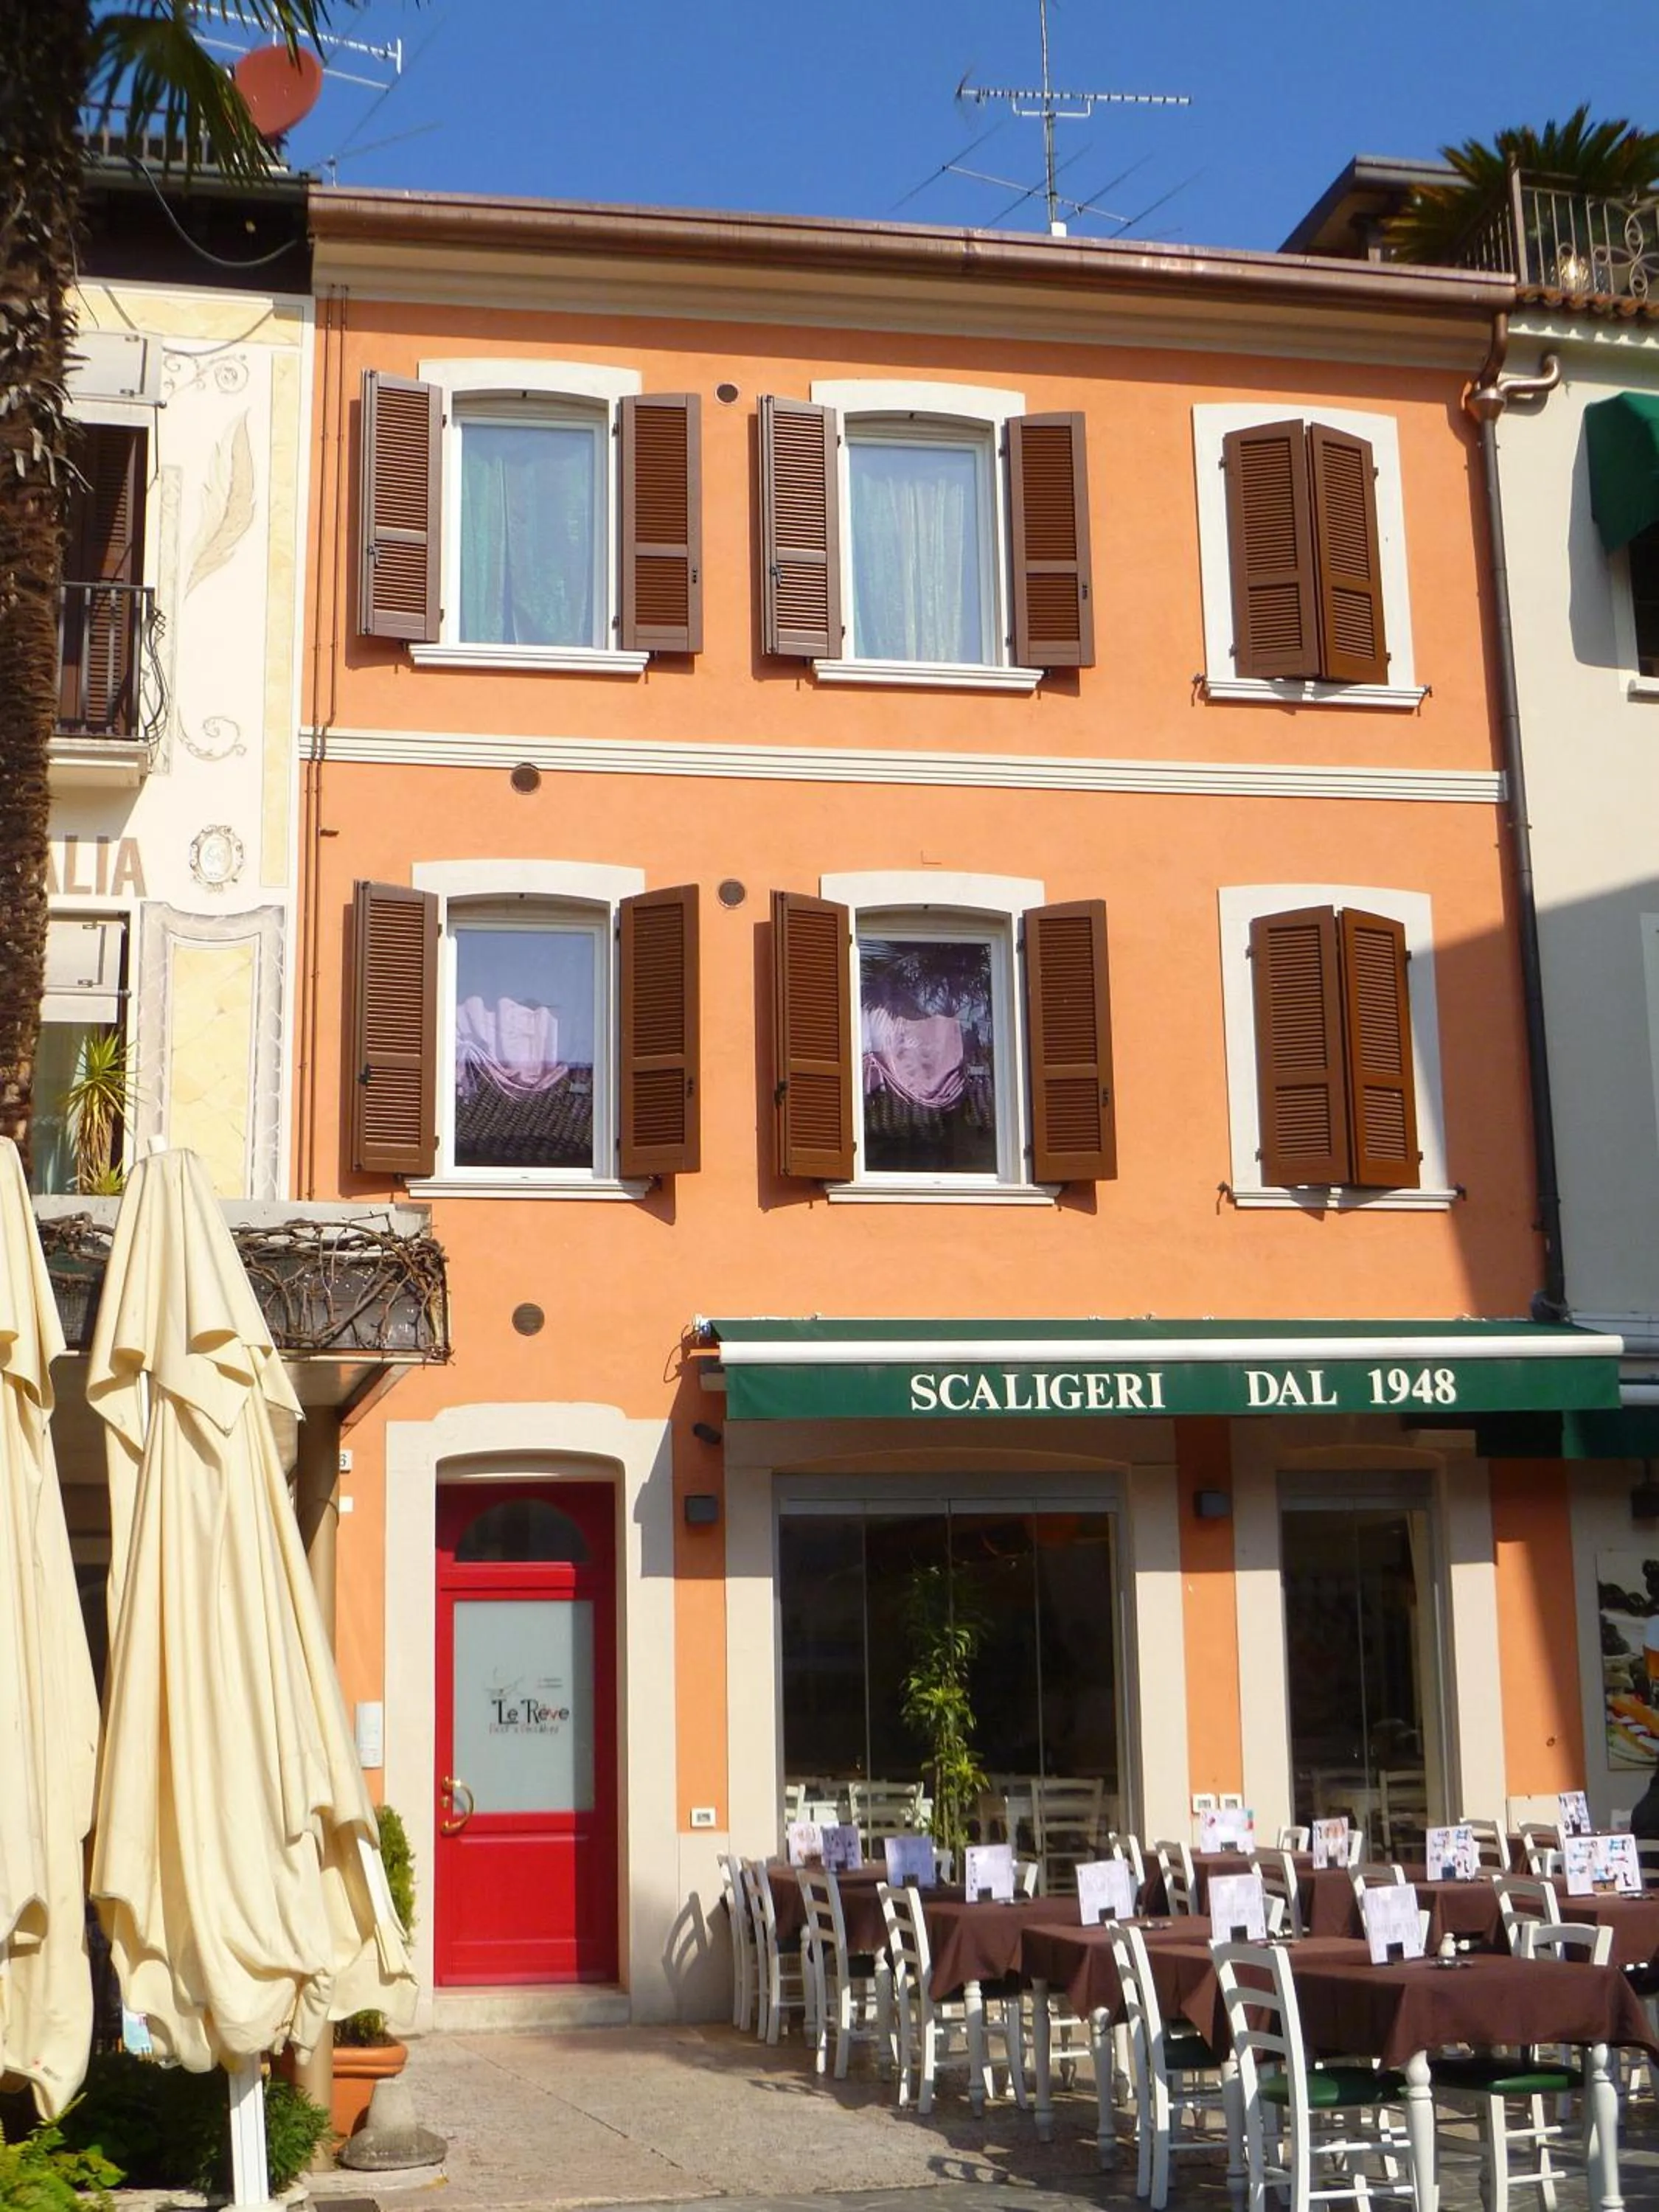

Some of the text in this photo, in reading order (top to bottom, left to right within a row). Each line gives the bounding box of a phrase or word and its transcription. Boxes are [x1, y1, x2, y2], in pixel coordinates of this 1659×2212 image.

[910, 1368, 1457, 1411] SCALIGERI DAL 1948
[491, 1698, 518, 1725] Le
